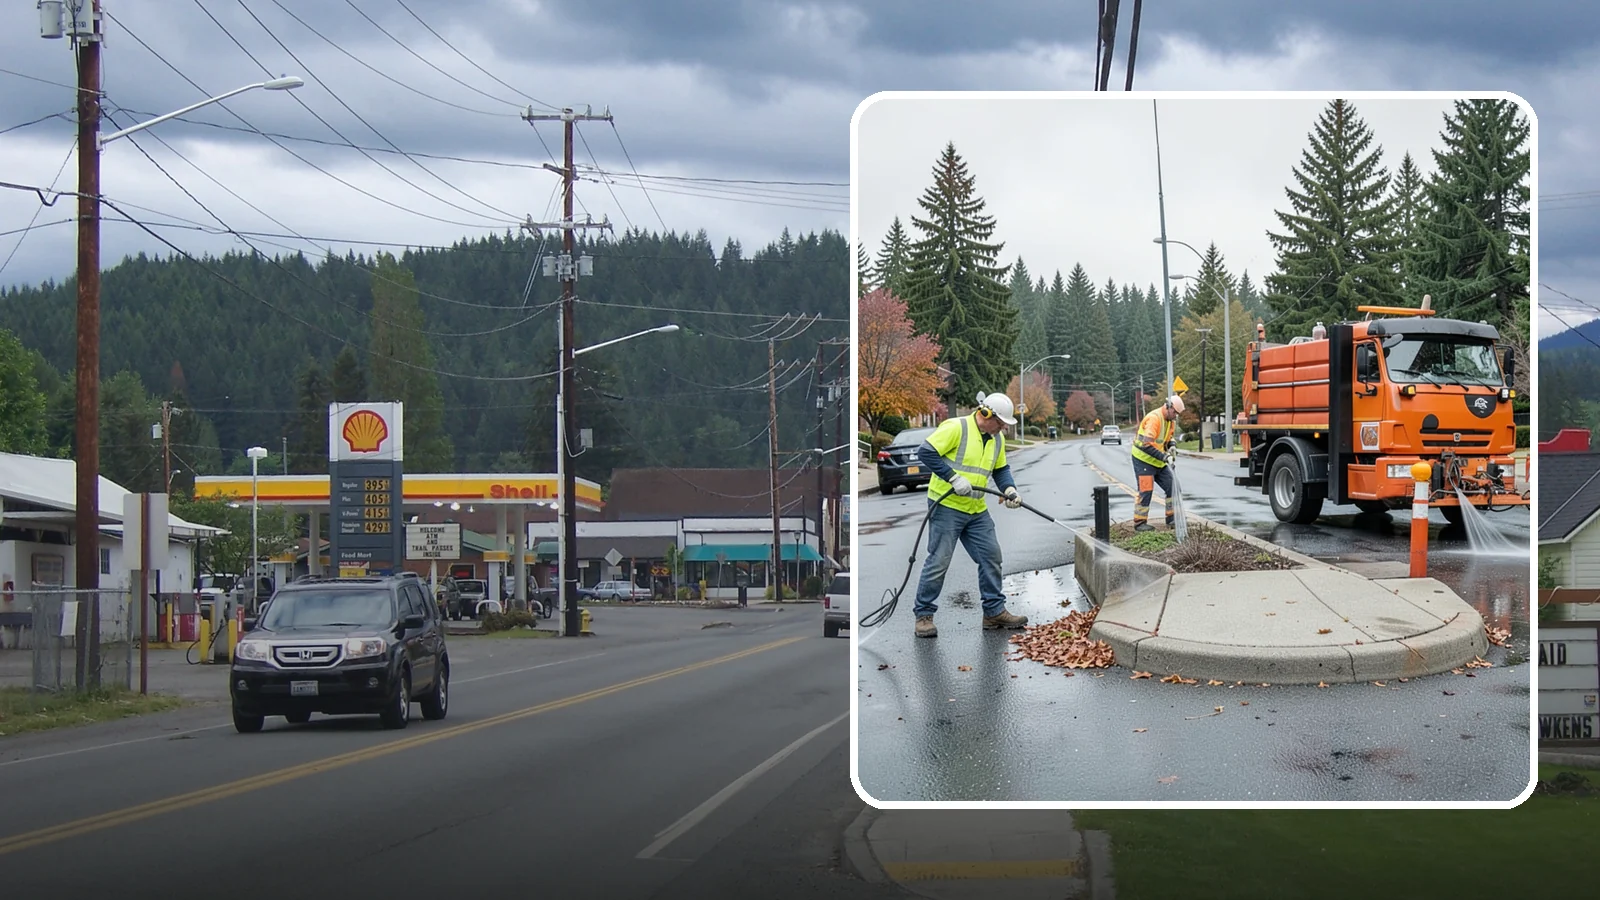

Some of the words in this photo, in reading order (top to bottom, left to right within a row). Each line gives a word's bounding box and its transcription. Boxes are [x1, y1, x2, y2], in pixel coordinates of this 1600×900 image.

[366, 480, 383, 490] 395
[490, 484, 547, 499] Shell
[366, 494, 383, 504] 405
[366, 508, 383, 518] 415
[366, 522, 383, 532] 429
[1539, 643, 1566, 665] AID
[1539, 715, 1592, 738] WKENS
